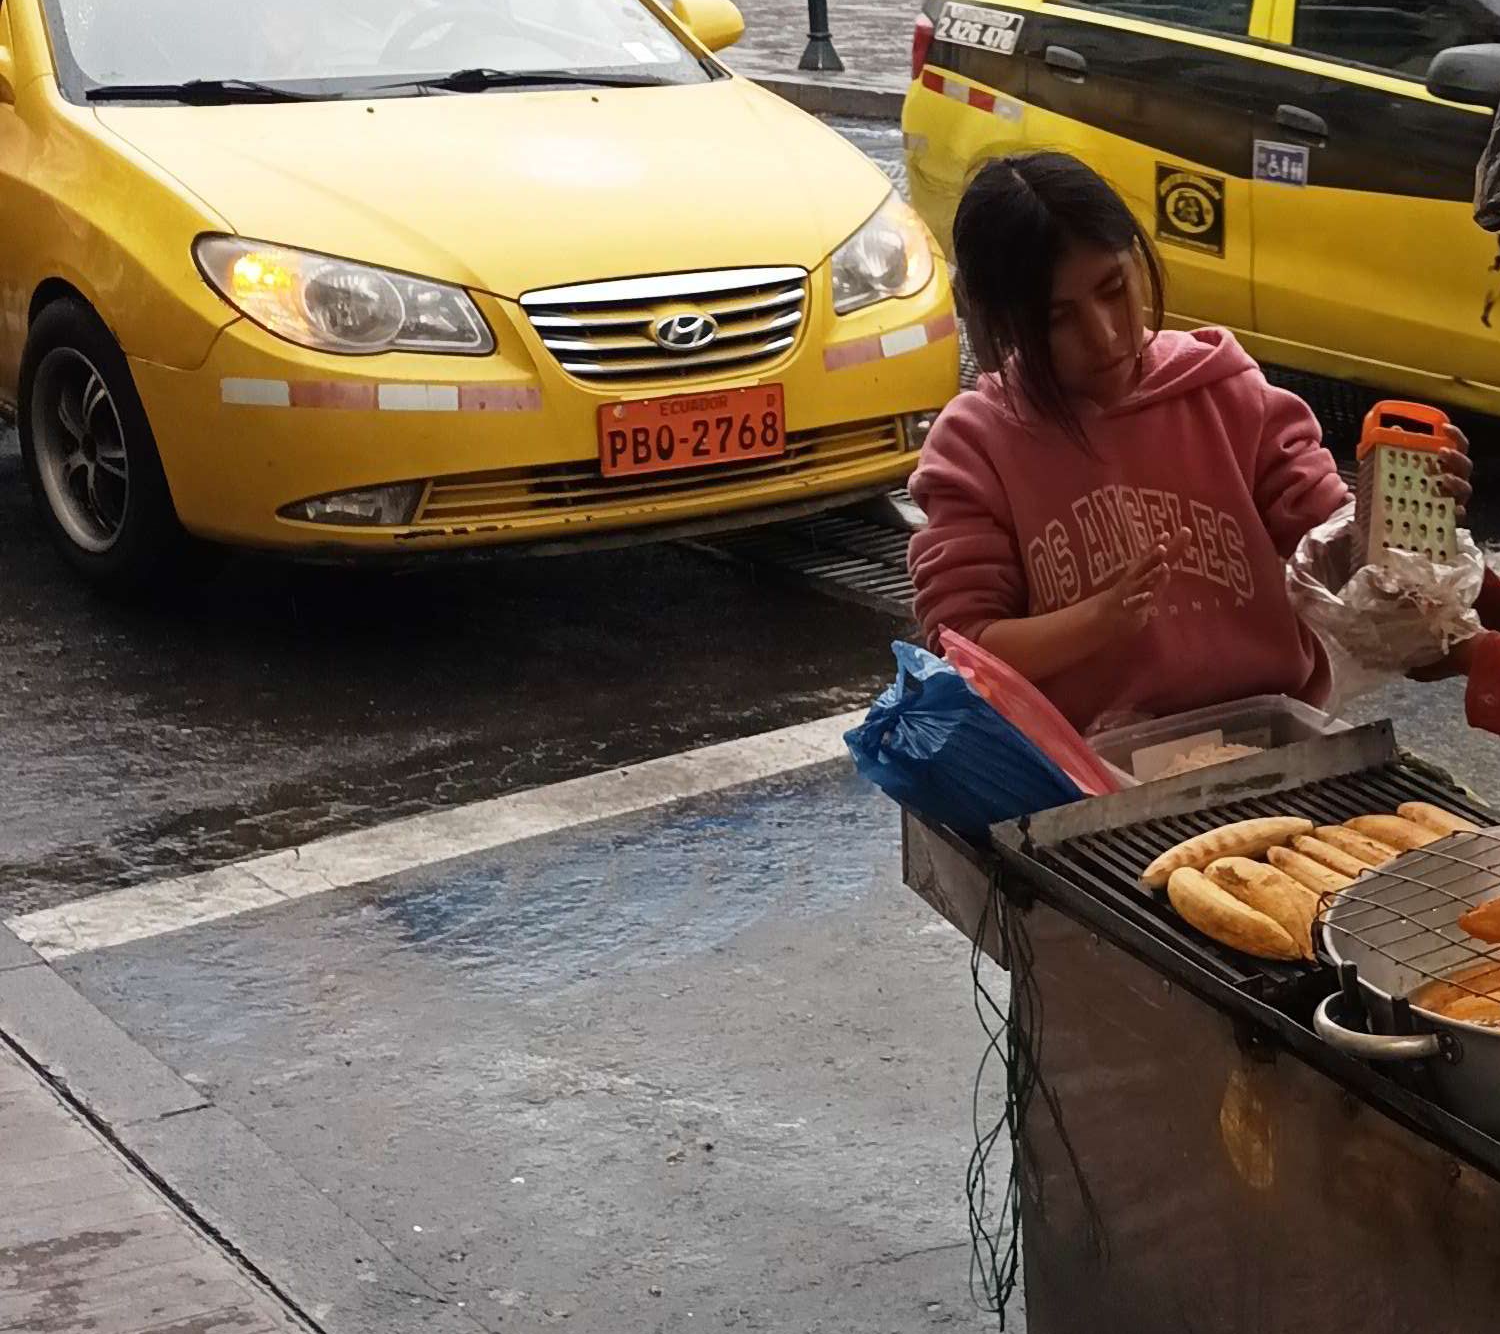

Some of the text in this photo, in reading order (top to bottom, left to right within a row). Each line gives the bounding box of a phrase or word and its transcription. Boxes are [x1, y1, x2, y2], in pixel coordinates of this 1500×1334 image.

[660, 395, 728, 416] ECUADOR
[1027, 484, 1255, 611] OS ANGELES
